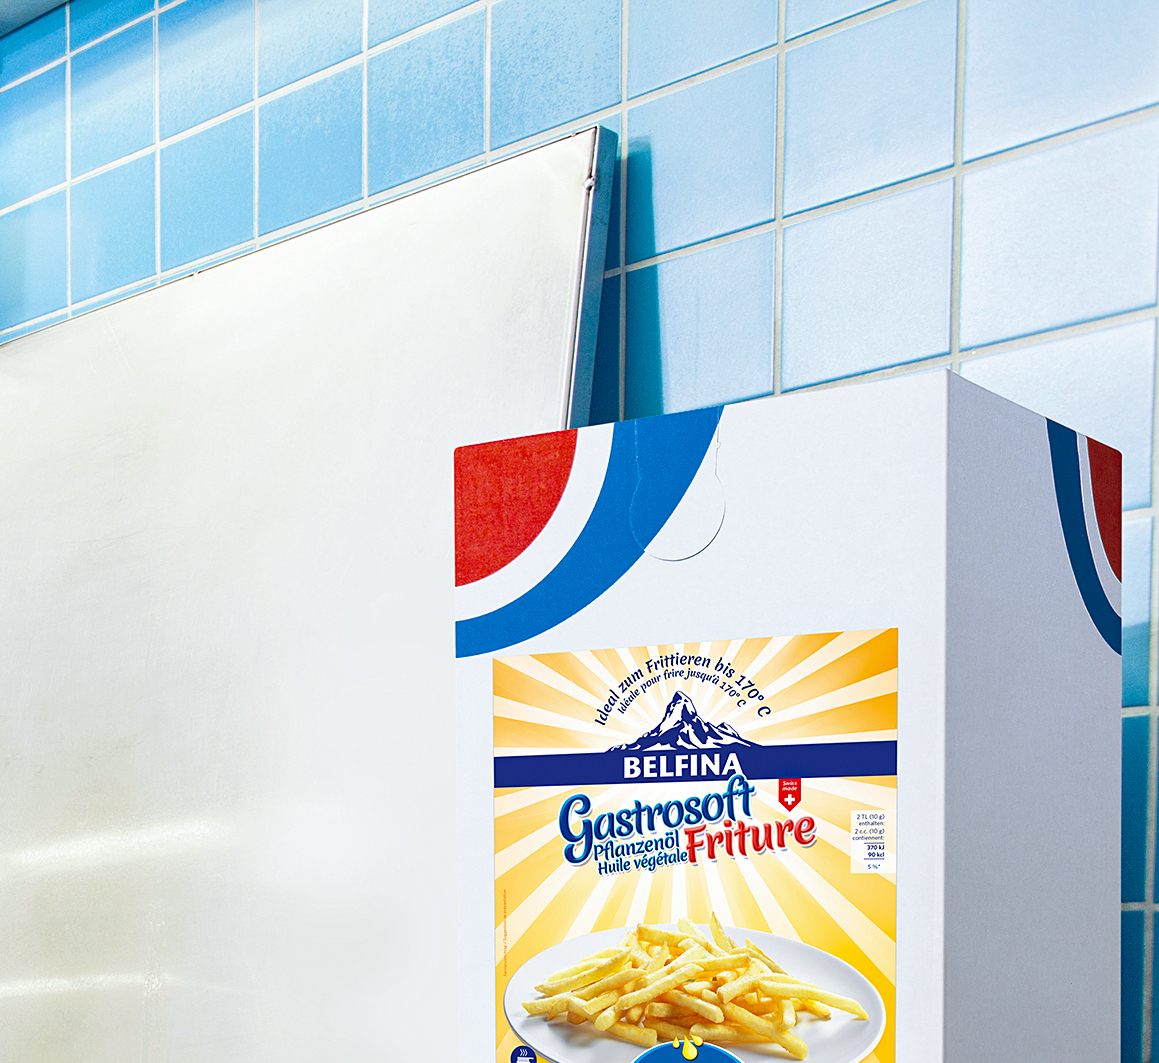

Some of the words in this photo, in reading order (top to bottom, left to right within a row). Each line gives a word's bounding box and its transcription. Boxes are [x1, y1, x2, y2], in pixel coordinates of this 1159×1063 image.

[594, 689, 620, 726] Ideal
[618, 669, 644, 694] zum
[645, 652, 711, 673] Frittieren
[714, 656, 736, 678] bis
[735, 675, 765, 701] 170°
[757, 706, 771, 717] C
[617, 688, 641, 714] Idéale
[640, 674, 661, 693] pour
[663, 668, 685, 680] frire
[719, 681, 741, 697] 170°
[736, 699, 747, 707] C
[623, 752, 743, 778] BELFINA
[559, 774, 756, 864] Gastrosoft
[684, 816, 816, 863] Friture
[594, 829, 679, 861] Pflanzenöl
[598, 859, 631, 875] Huile
[634, 849, 688, 872] végétale
